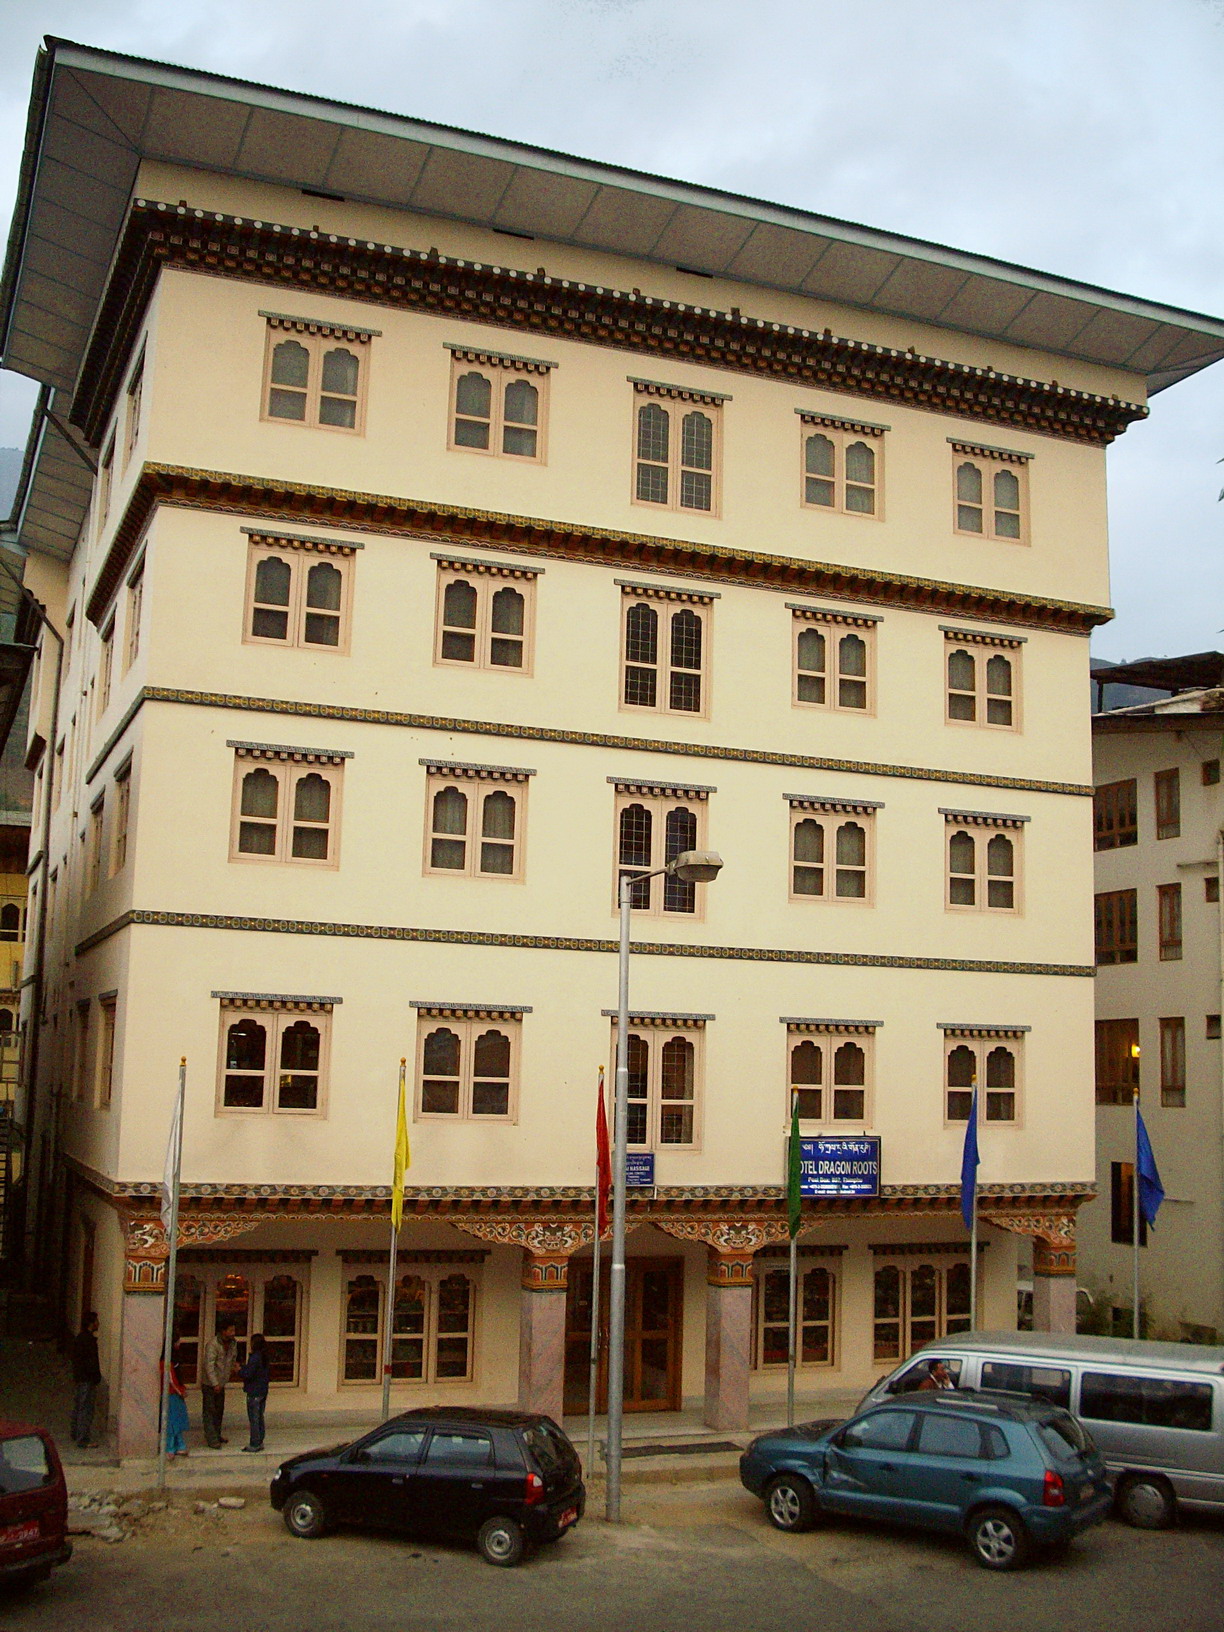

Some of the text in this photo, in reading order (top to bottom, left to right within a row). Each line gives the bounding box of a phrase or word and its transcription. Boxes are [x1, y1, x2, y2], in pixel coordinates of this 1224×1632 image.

[800, 1160, 878, 1175] OTEL DRAGON ROOTS
